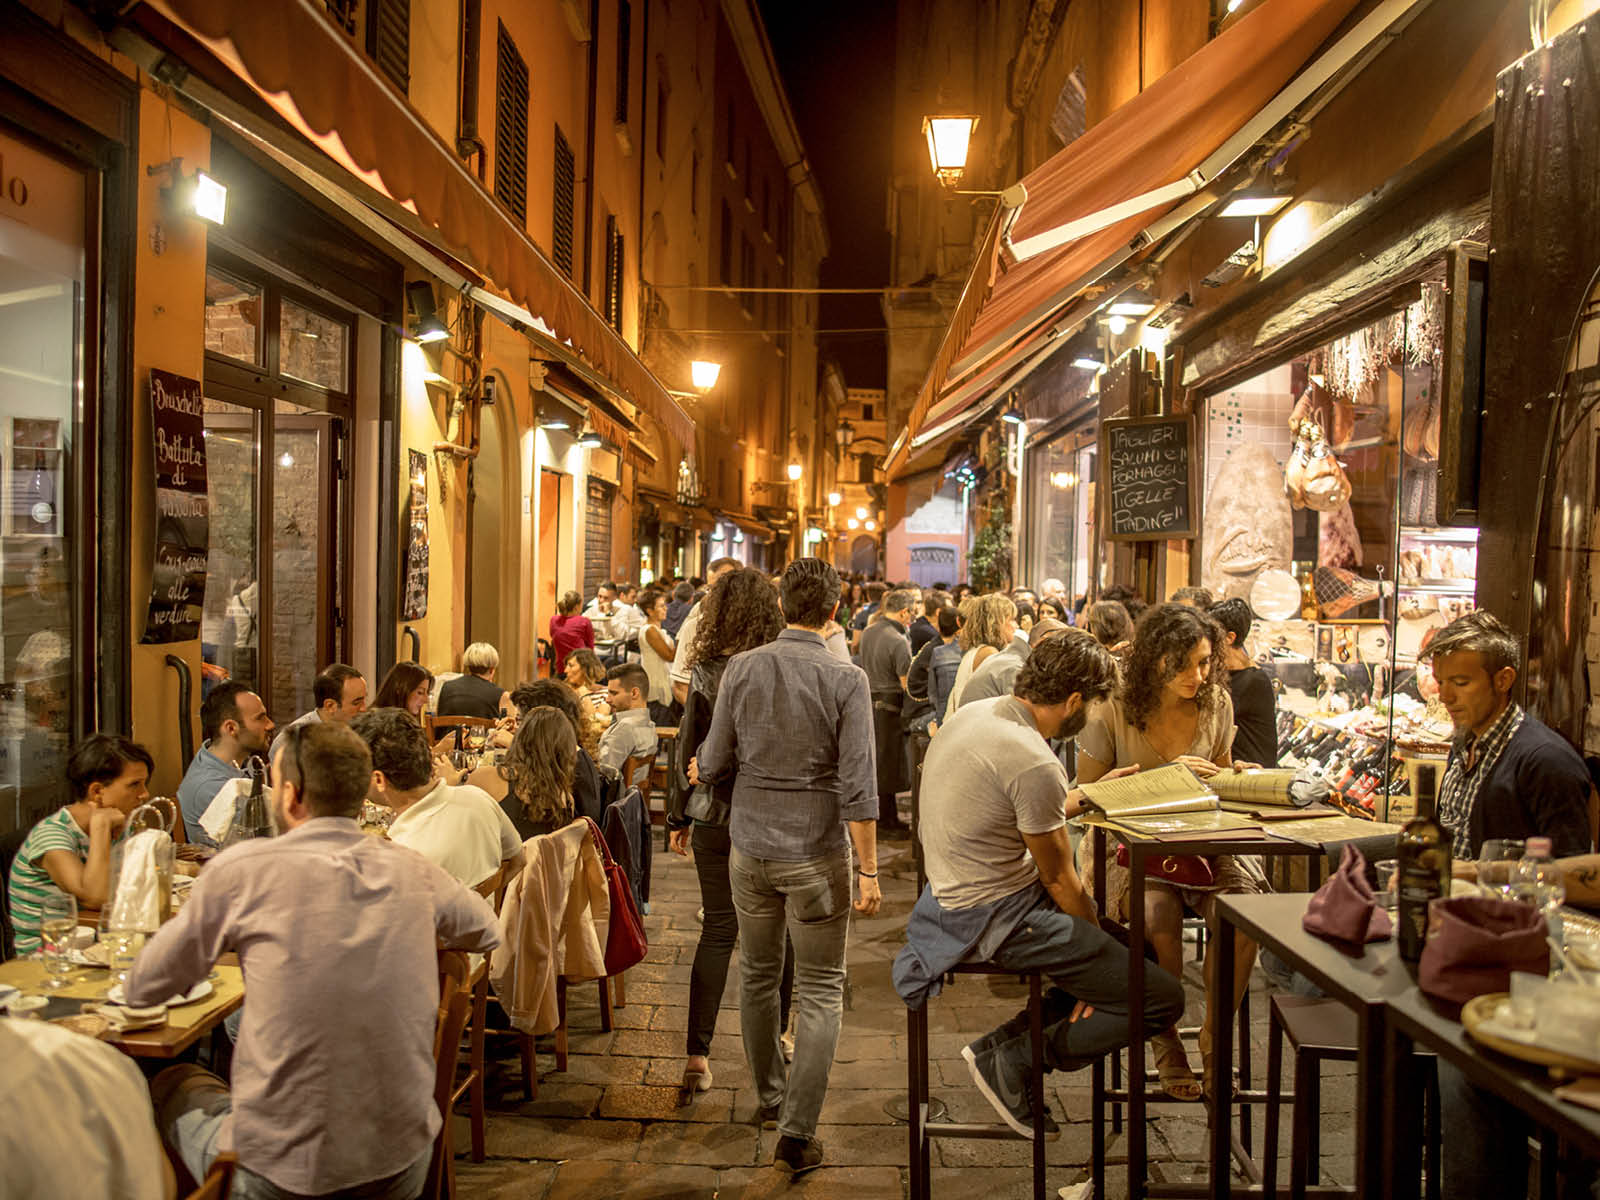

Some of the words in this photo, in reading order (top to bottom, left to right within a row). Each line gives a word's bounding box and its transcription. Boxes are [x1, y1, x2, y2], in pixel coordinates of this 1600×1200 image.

[157, 427, 203, 466] Battuta
[1111, 448, 1160, 466] SALUMI
[172, 464, 188, 485] di
[1112, 464, 1176, 484] FORMAGGI
[1112, 487, 1176, 509] TIGELLE
[168, 575, 190, 601] alle
[154, 603, 193, 625] verdure
